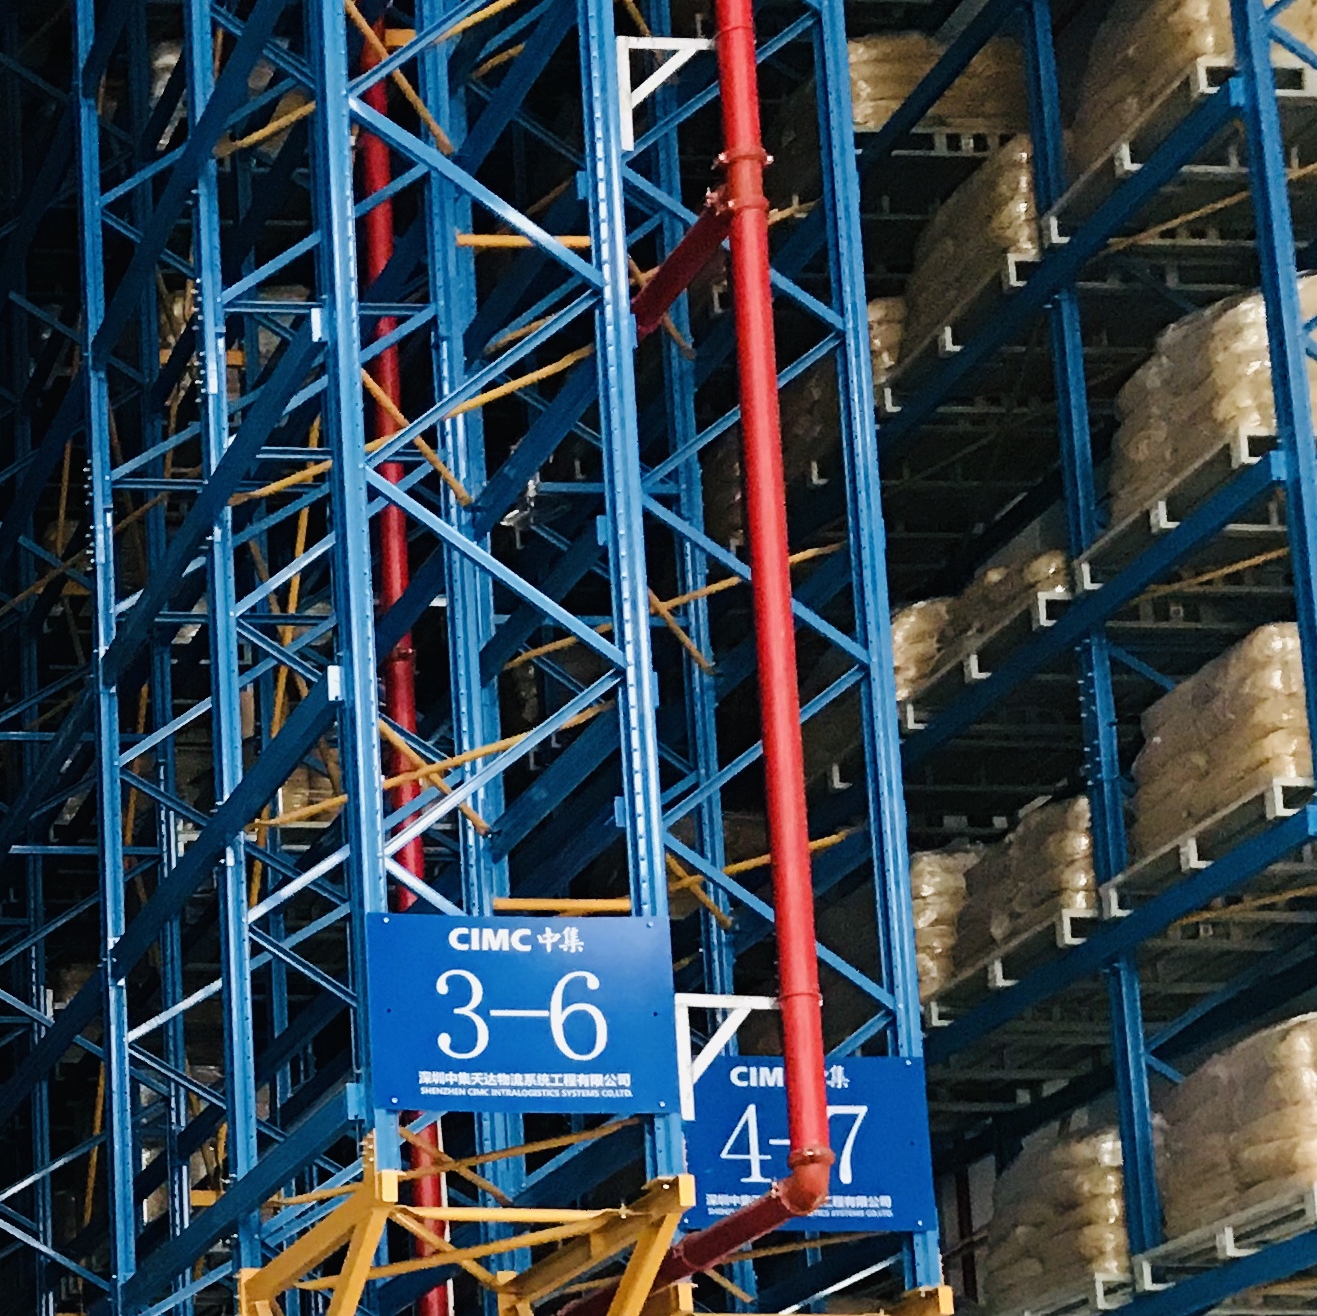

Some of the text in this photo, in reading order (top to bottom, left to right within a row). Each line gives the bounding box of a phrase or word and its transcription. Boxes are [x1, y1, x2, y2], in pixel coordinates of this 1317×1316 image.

[448, 926, 584, 953] CIMC 中集
[730, 1066, 785, 1087] CIM
